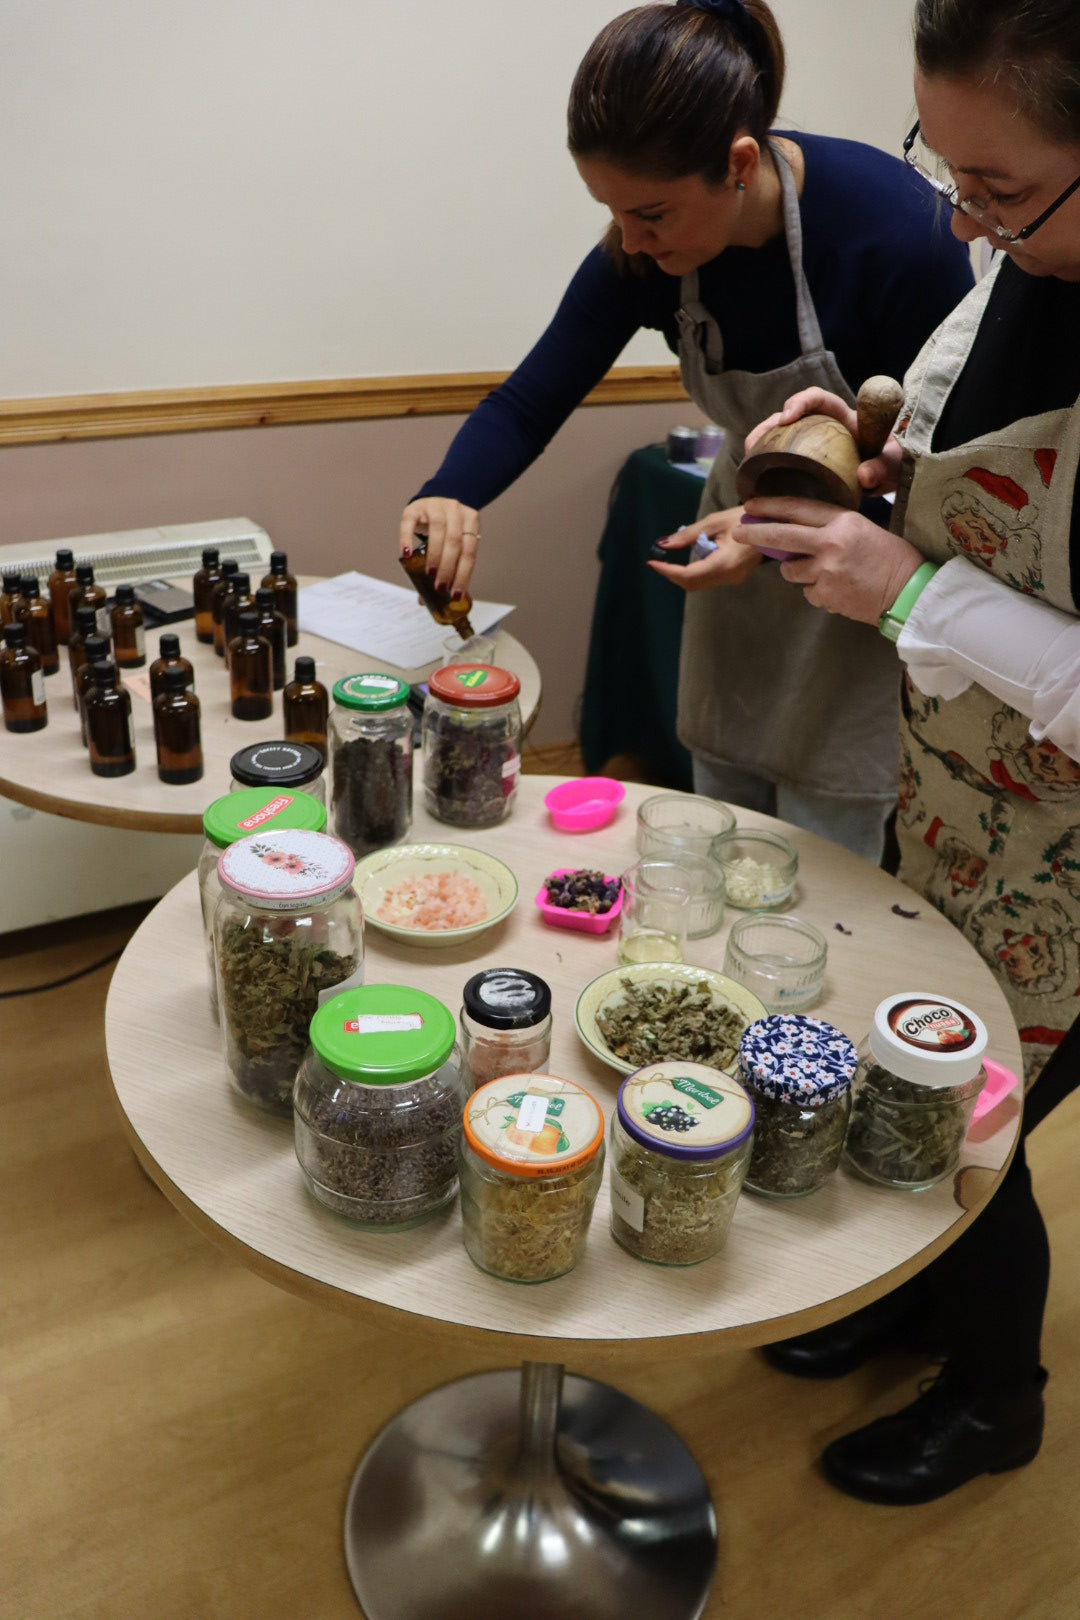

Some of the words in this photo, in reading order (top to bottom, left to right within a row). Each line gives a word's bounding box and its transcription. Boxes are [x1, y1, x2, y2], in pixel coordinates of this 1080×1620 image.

[243, 798, 289, 827] Freshona
[904, 1009, 951, 1036] Choco
[677, 1078, 720, 1105] Maribel
